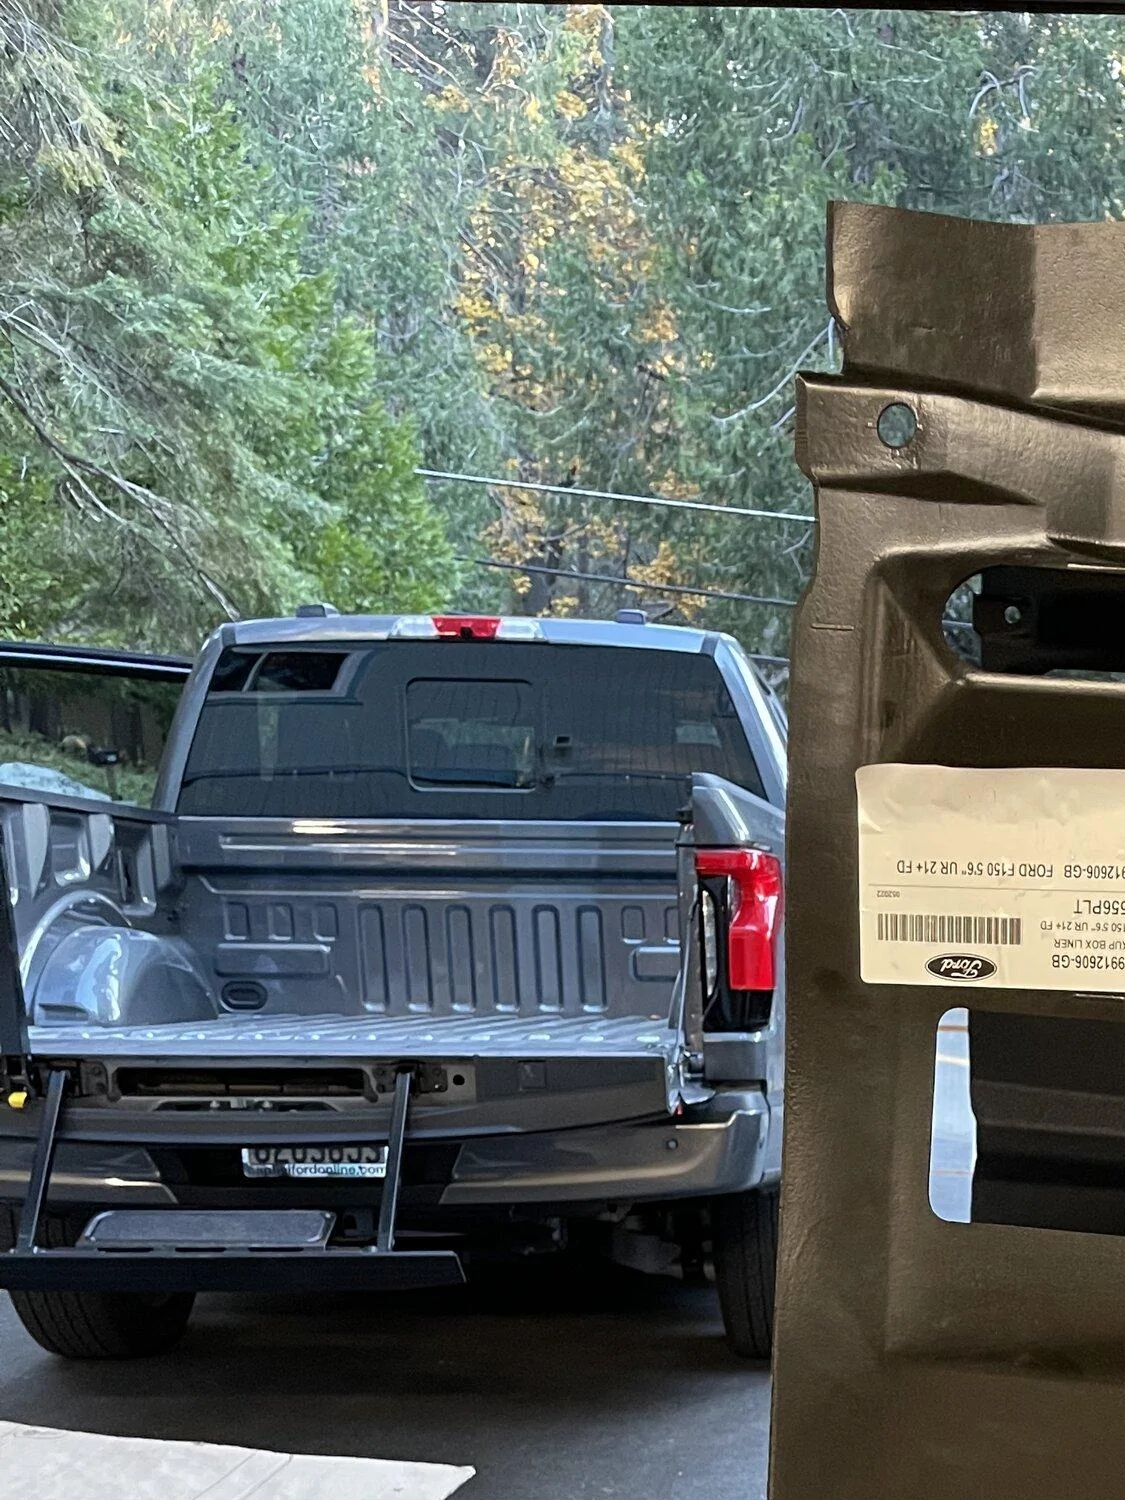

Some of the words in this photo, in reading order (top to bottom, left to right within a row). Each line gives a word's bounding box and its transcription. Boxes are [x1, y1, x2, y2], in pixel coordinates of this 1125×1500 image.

[896, 860, 912, 874] FD
[916, 860, 937, 875] 21+
[940, 861, 958, 875] UR
[987, 862, 1015, 877] F150
[1018, 863, 1053, 878] FORD
[1040, 920, 1053, 931] FD
[1056, 920, 1072, 931] 21+
[1074, 921, 1089, 932] UR
[1054, 938, 1083, 949] LINER
[1085, 939, 1106, 950] BOX
[939, 957, 983, 979] Ford
